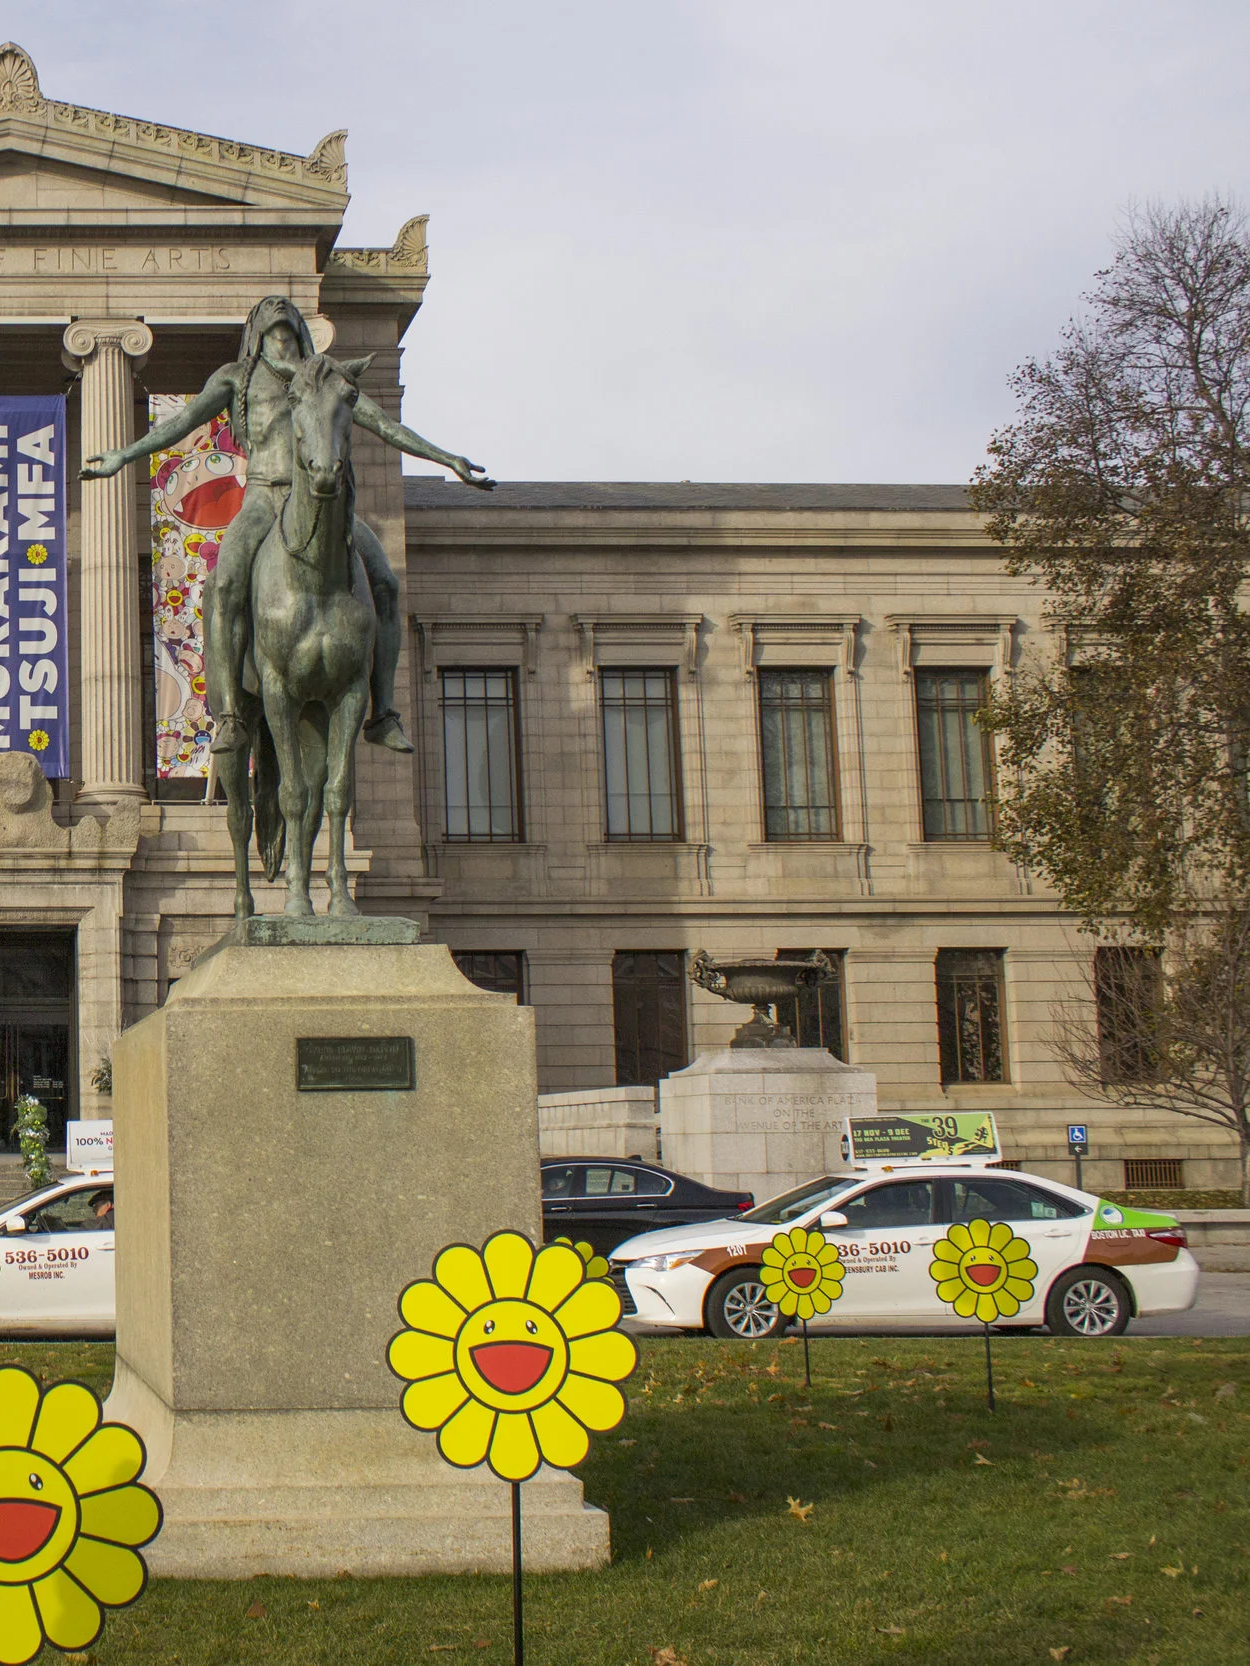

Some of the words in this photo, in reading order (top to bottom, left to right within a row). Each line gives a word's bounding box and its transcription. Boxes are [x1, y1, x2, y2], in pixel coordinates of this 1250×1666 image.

[33, 248, 118, 270] FINE
[141, 247, 231, 270] ARTS
[17, 424, 56, 540] MFA
[18, 568, 58, 730] TSUJI
[725, 1096, 754, 1105] BANK
[758, 1096, 773, 1105] OF
[778, 1096, 825, 1105] AMERICA
[828, 1096, 863, 1105] PLAZA
[773, 1109, 790, 1118] ON
[793, 1109, 815, 1118] THE
[737, 1121, 779, 1130] AVENUE
[782, 1121, 797, 1130] OF
[801, 1121, 822, 1130] THE
[824, 1121, 843, 1130] ART
[932, 1116, 958, 1138] 39
[76, 1137, 104, 1146] 100%
[1091, 1230, 1118, 1239] BOSTON
[1131, 1228, 1146, 1238] TAXI
[838, 1240, 911, 1257] 36-5010
[5, 1247, 89, 1264] 536-5010
[863, 1255, 888, 1264] Operated
[44, 1262, 68, 1270] Operated
[875, 1265, 887, 1273] CAB
[888, 1264, 900, 1272] INC.
[29, 1271, 52, 1279] MESROB
[54, 1271, 65, 1279] INC.
